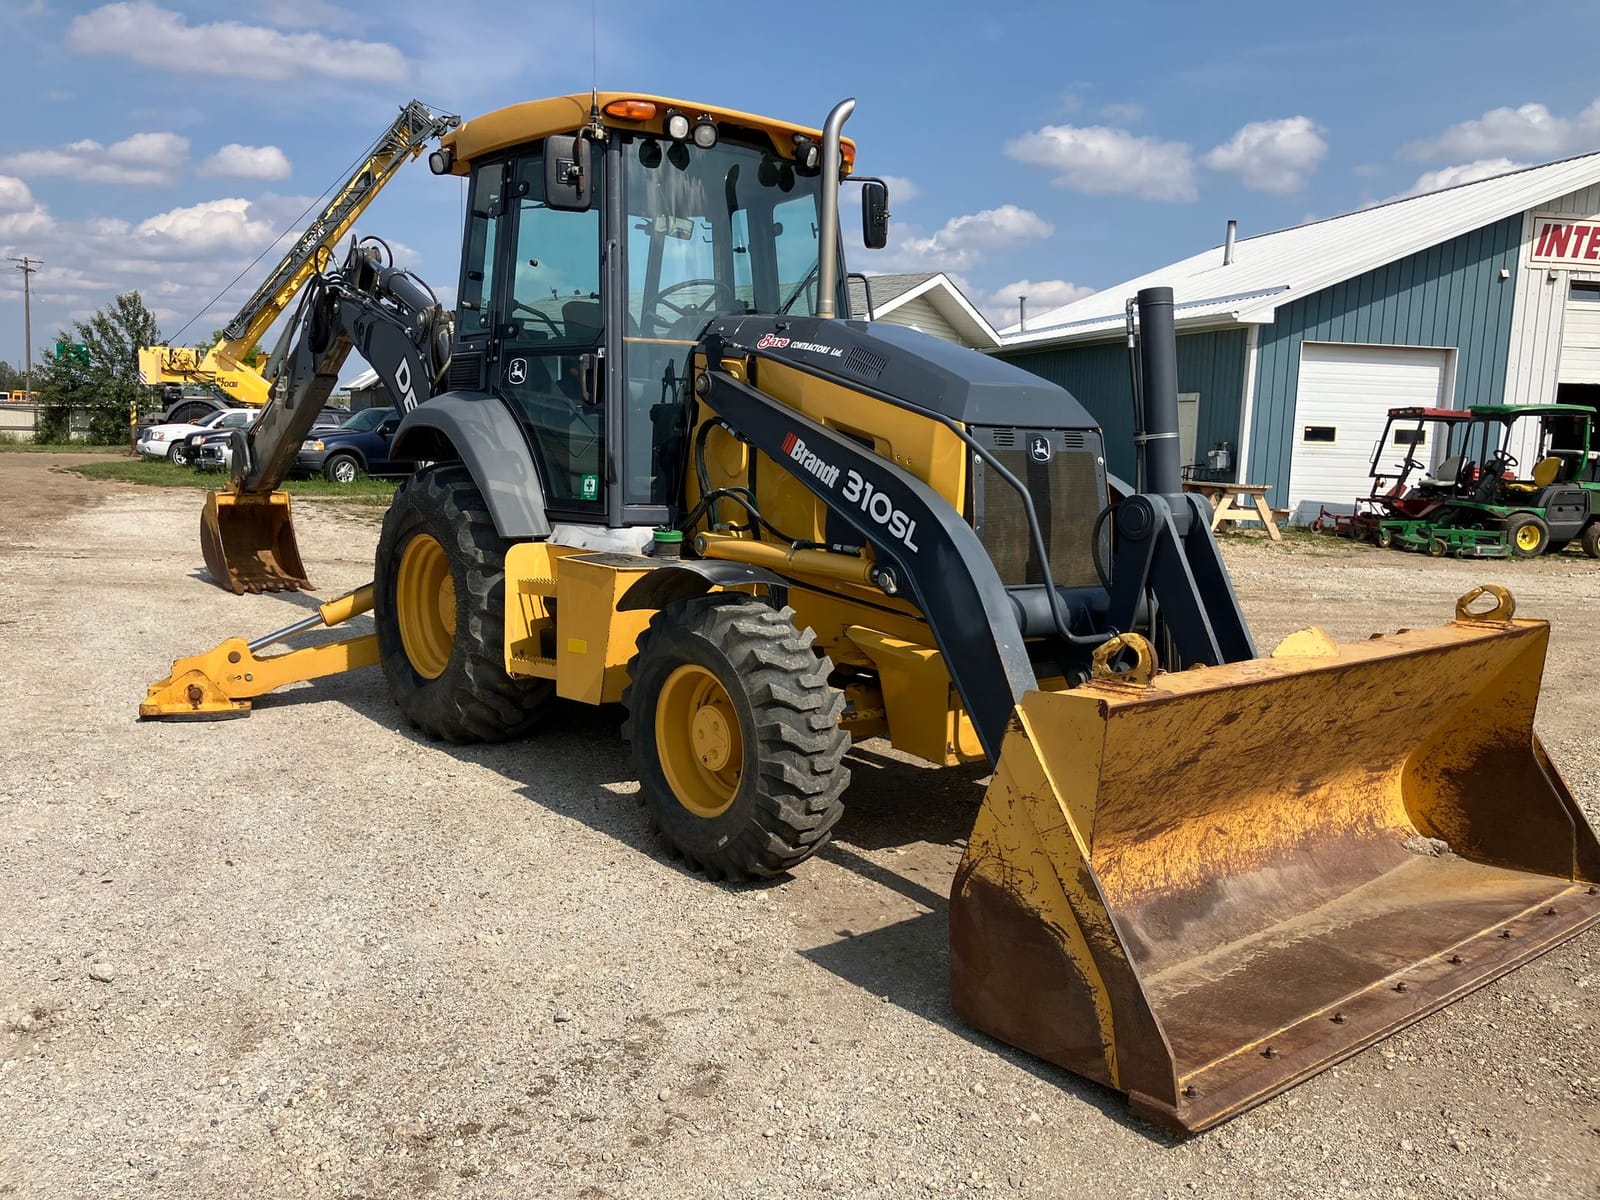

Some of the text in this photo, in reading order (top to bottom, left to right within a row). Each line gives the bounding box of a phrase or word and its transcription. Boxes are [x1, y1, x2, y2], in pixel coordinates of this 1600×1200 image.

[757, 333, 790, 349] Bare
[790, 341, 831, 354] CONTRACTORS
[394, 356, 418, 413] DE
[790, 438, 840, 489] Brandt
[842, 469, 919, 553] 310SL
